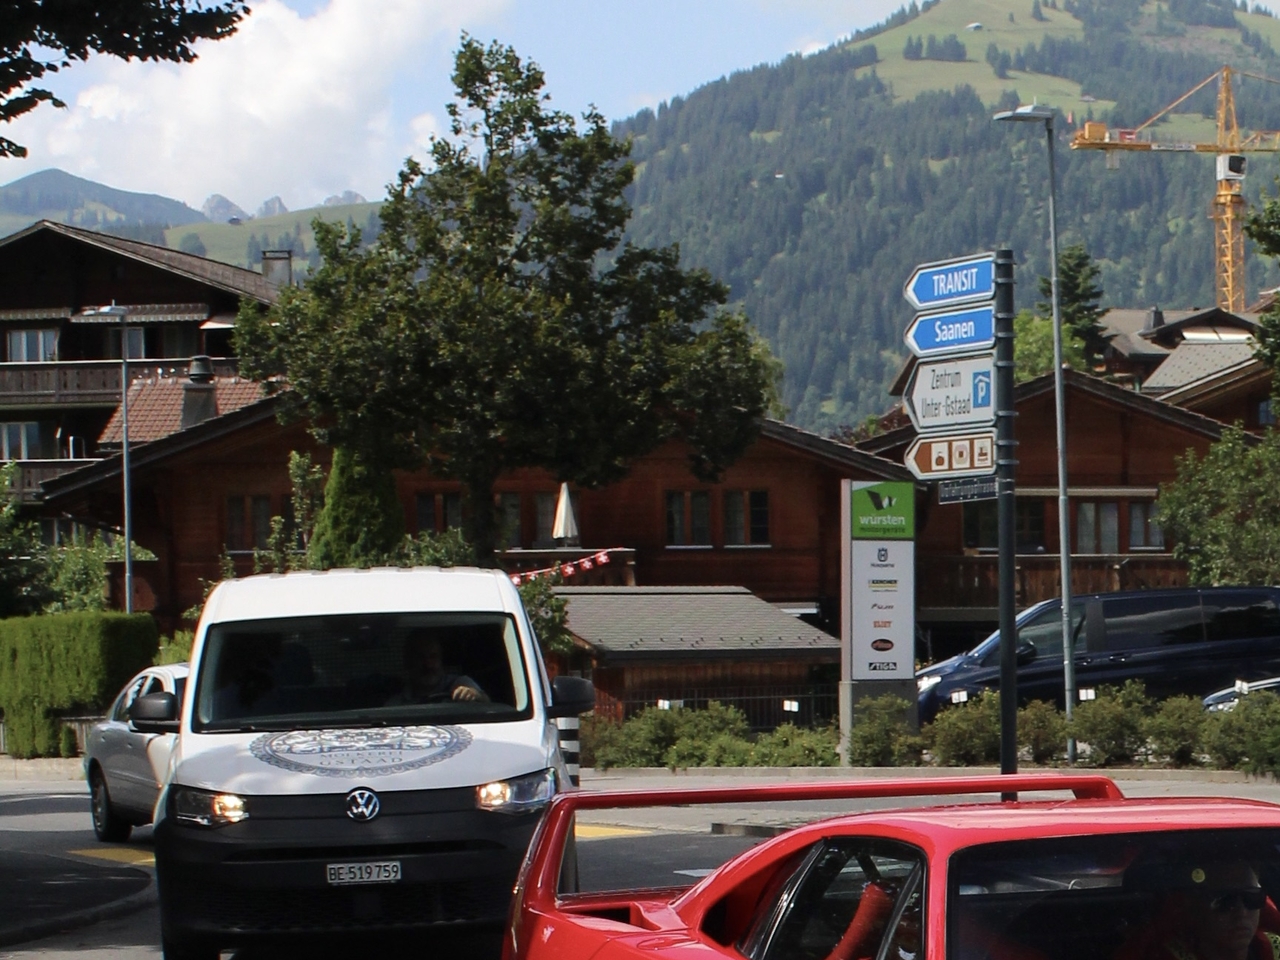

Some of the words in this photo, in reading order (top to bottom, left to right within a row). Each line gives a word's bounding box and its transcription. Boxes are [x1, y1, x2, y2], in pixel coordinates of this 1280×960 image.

[932, 268, 978, 296] TRANSIT
[934, 320, 975, 343] Saanen
[930, 368, 962, 390] Zentrum
[921, 392, 972, 418] Unter-Gstaad
[869, 662, 897, 670] STIGA
[319, 757, 403, 765] GSTAAD
